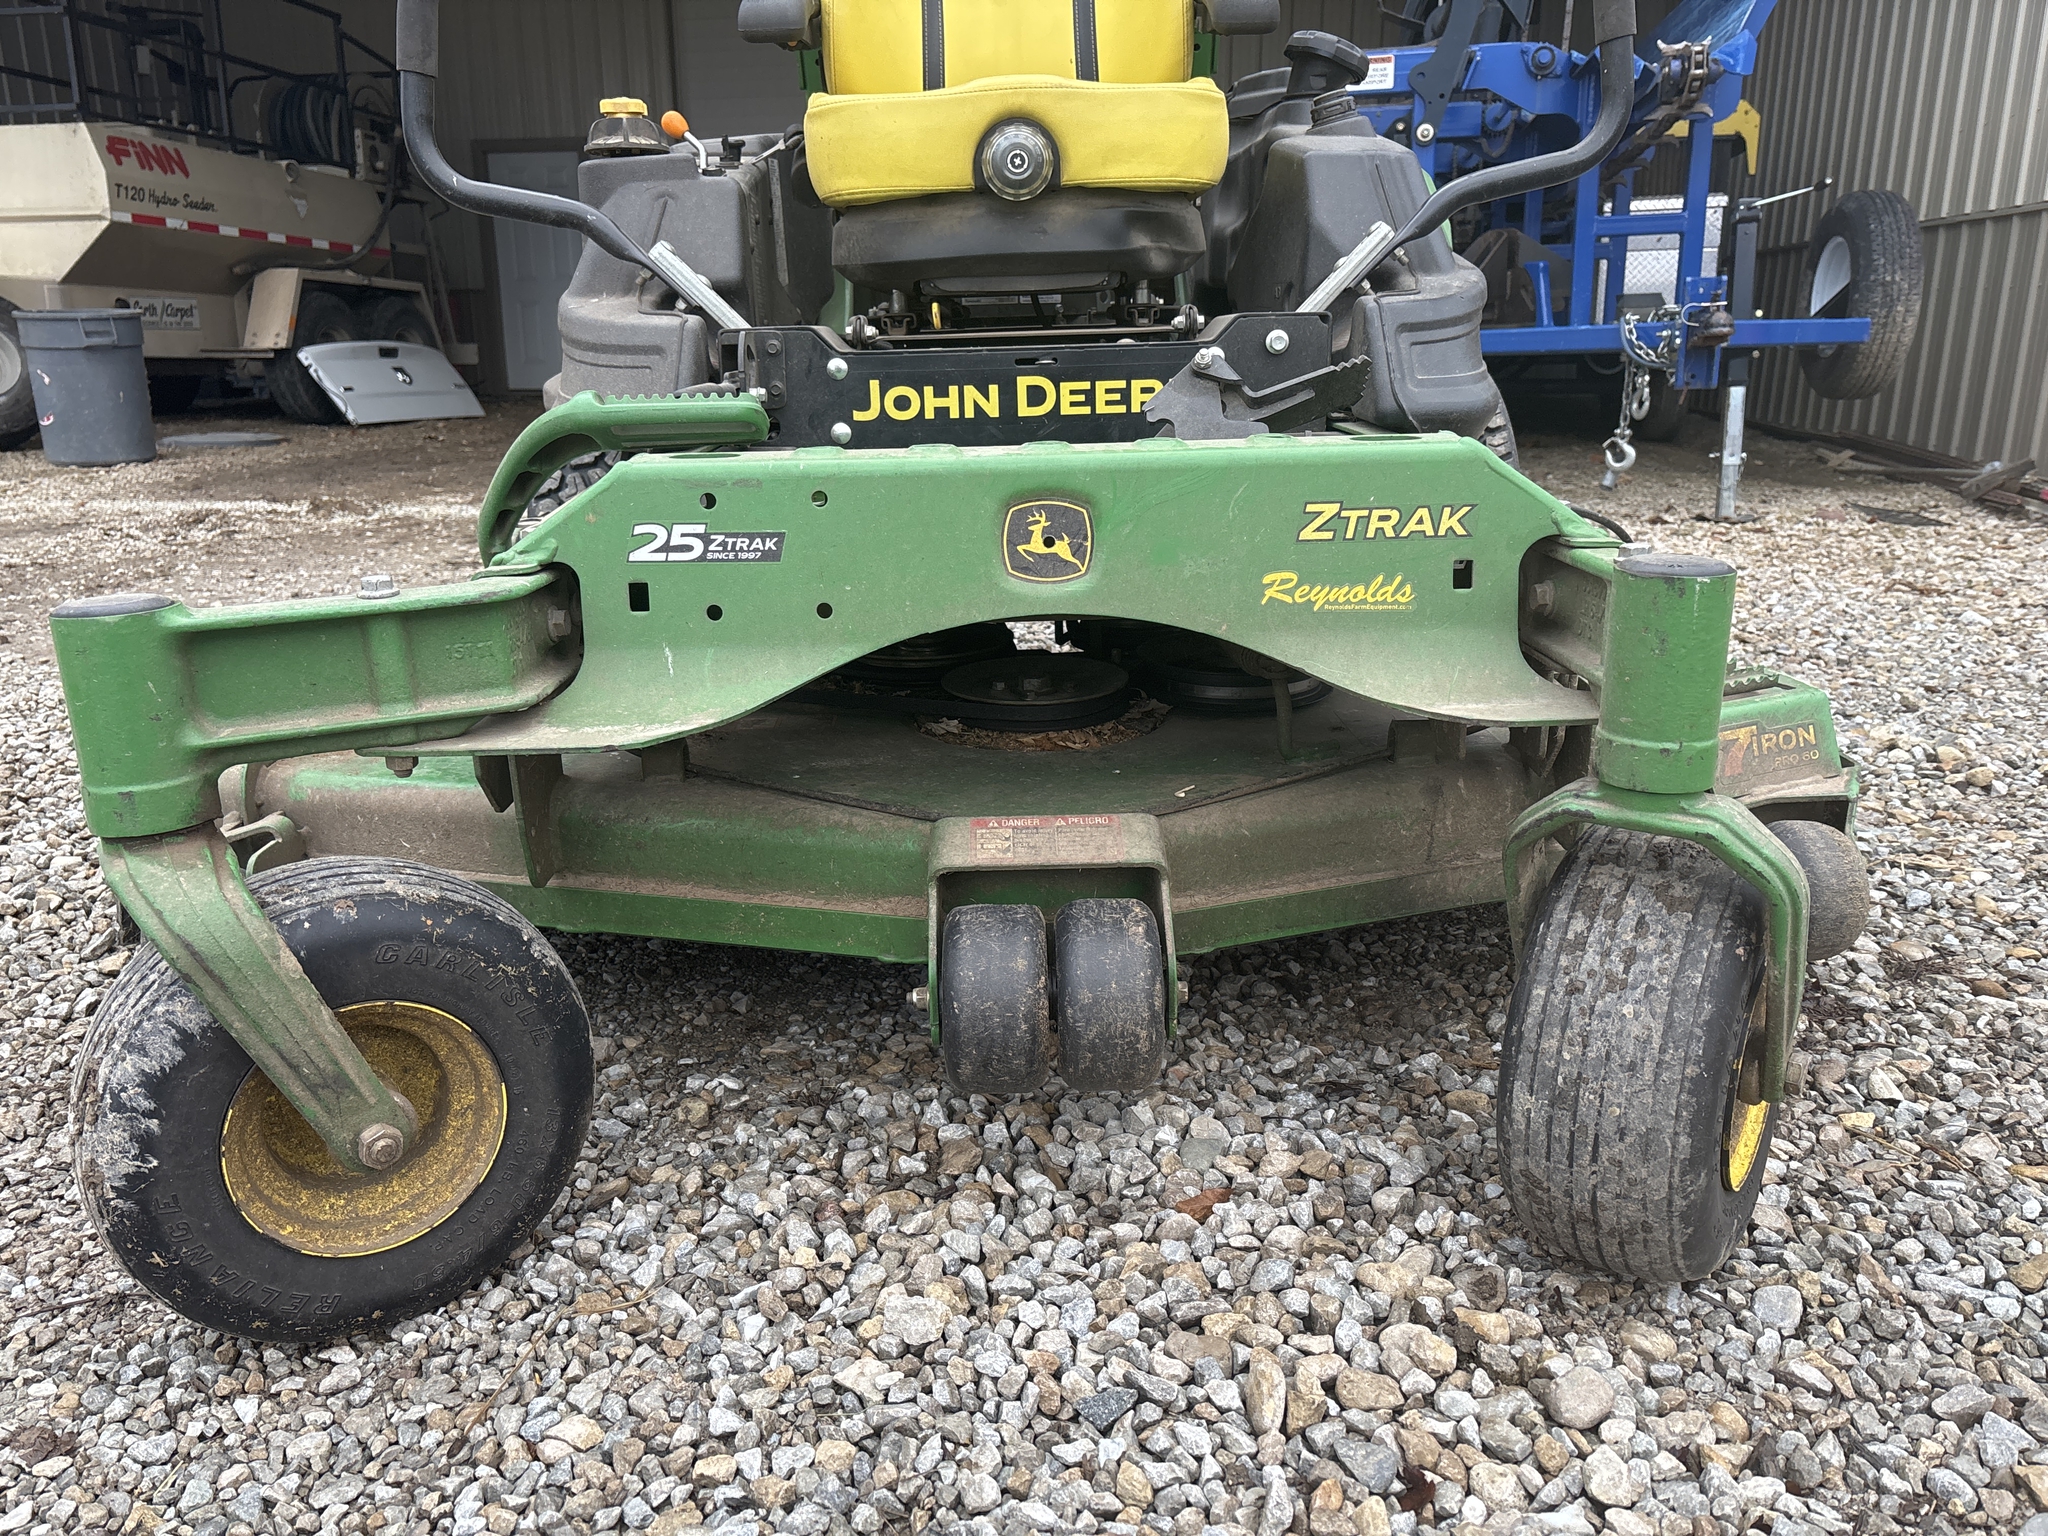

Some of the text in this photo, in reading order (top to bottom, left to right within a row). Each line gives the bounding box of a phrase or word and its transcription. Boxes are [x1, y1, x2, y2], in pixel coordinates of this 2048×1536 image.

[114, 183, 145, 203] T120
[148, 188, 180, 209] Hydro
[852, 375, 1168, 421] JOHN DEER
[1297, 501, 1477, 541] ZTRAK
[628, 522, 779, 562] 25 ZTRAK
[706, 552, 762, 560] SINCE 1997
[1261, 571, 1415, 611] Reynolds
[1718, 724, 1817, 777] 7 IRON
[1774, 749, 1820, 769] PRO 60
[1001, 818, 1040, 827] DANGER
[1068, 816, 1109, 825] PELIGRO
[375, 943, 554, 1047] CARLISLE
[514, 1129, 530, 1155] 460
[468, 1188, 502, 1224] LOAD
[153, 1192, 342, 1316] RELIANCE
